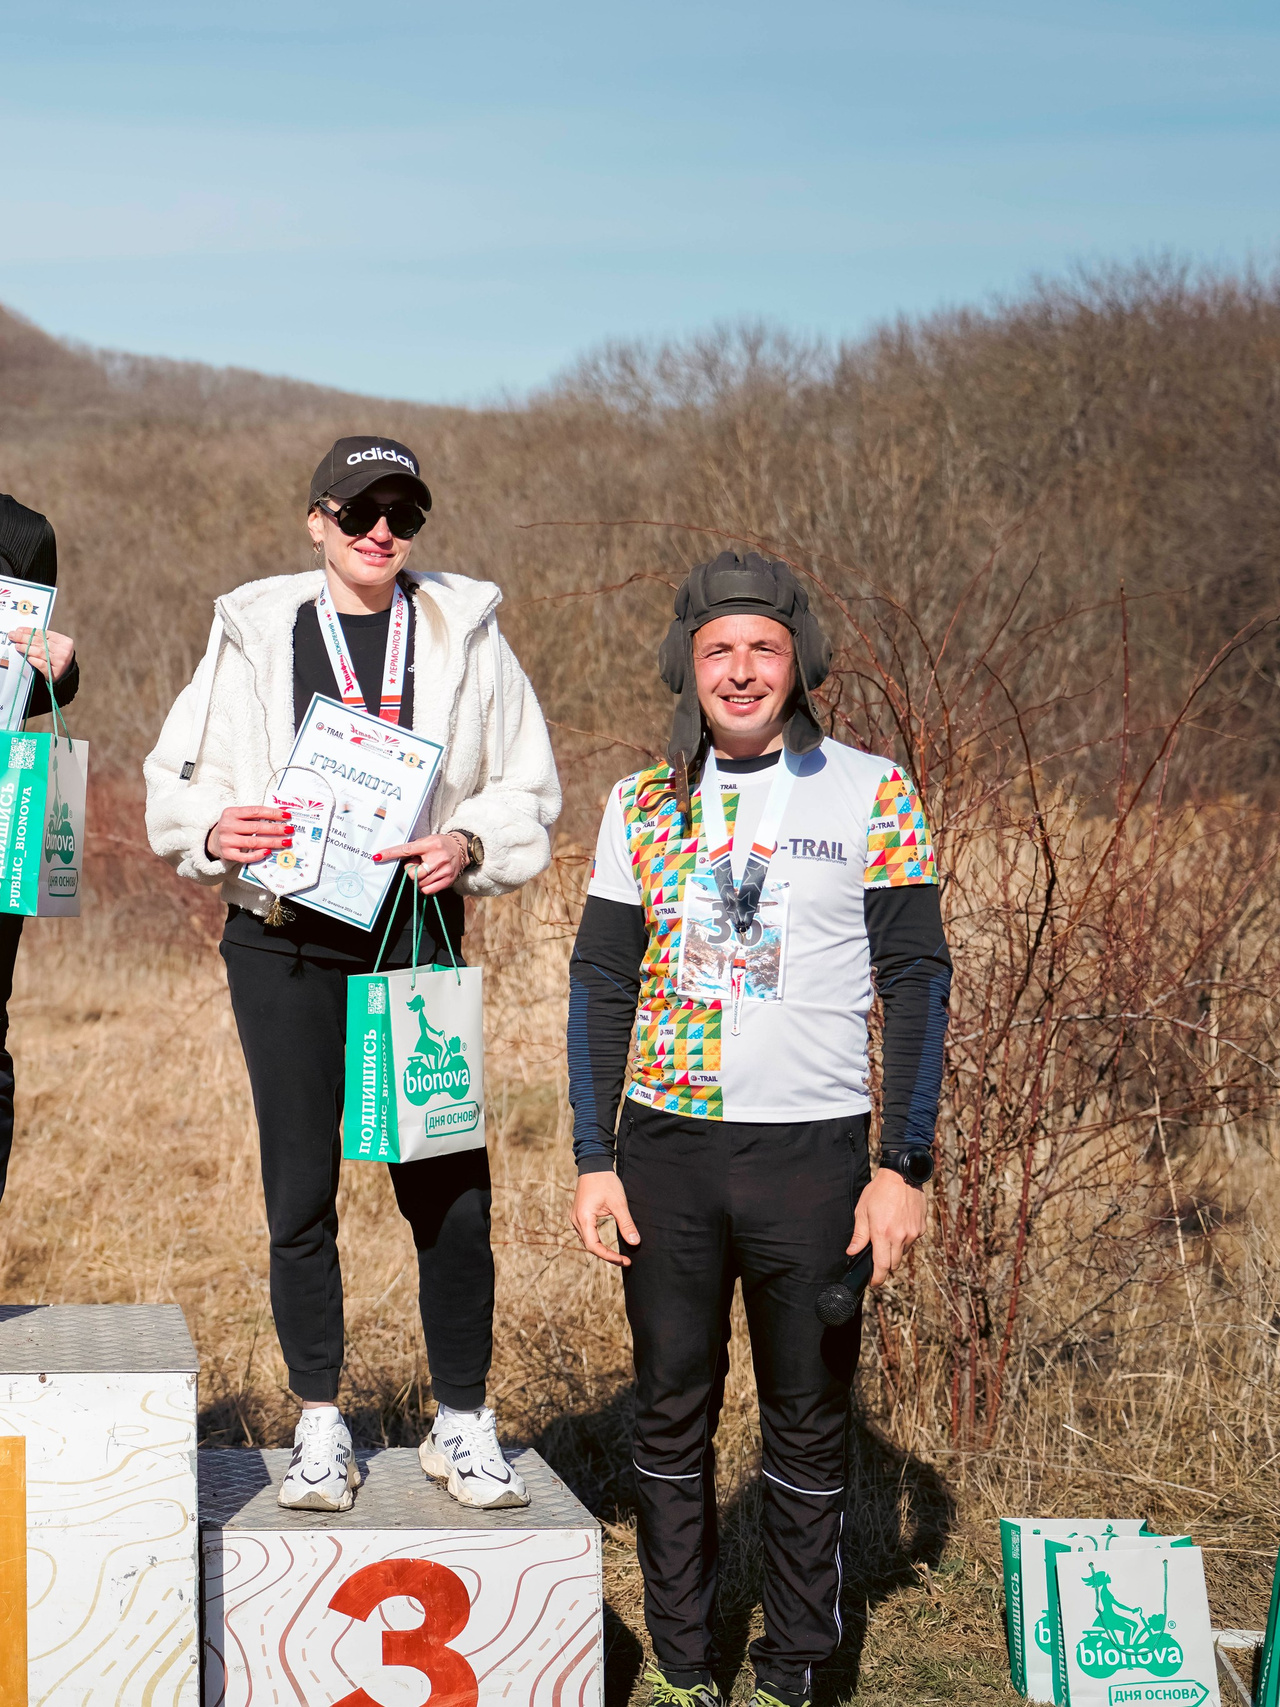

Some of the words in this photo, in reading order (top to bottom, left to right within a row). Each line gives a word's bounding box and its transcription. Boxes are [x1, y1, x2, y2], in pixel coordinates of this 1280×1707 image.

[346, 447, 416, 475] adidas
[389, 629, 401, 676] ЛЕРМОНТОВ
[310, 752, 401, 801] ГРАМОТА
[9, 786, 32, 908] PUBLIC_BIONOVA
[326, 836, 360, 854] ОКОЛЕНИЙ
[361, 851, 373, 861] 202
[358, 1029, 377, 1155] ПОДПИШИСЬ
[378, 1032, 388, 1156] PUBLIC_BIONOVA
[405, 1067, 470, 1094] bionova
[429, 1116, 446, 1129] ДНЯ
[447, 1109, 477, 1125] ОСНОВА
[327, 1558, 478, 1707] 3
[1079, 1641, 1182, 1667] bionova
[1114, 1690, 1142, 1704] ДНЯ
[1145, 1688, 1199, 1702] ОСНОВА
